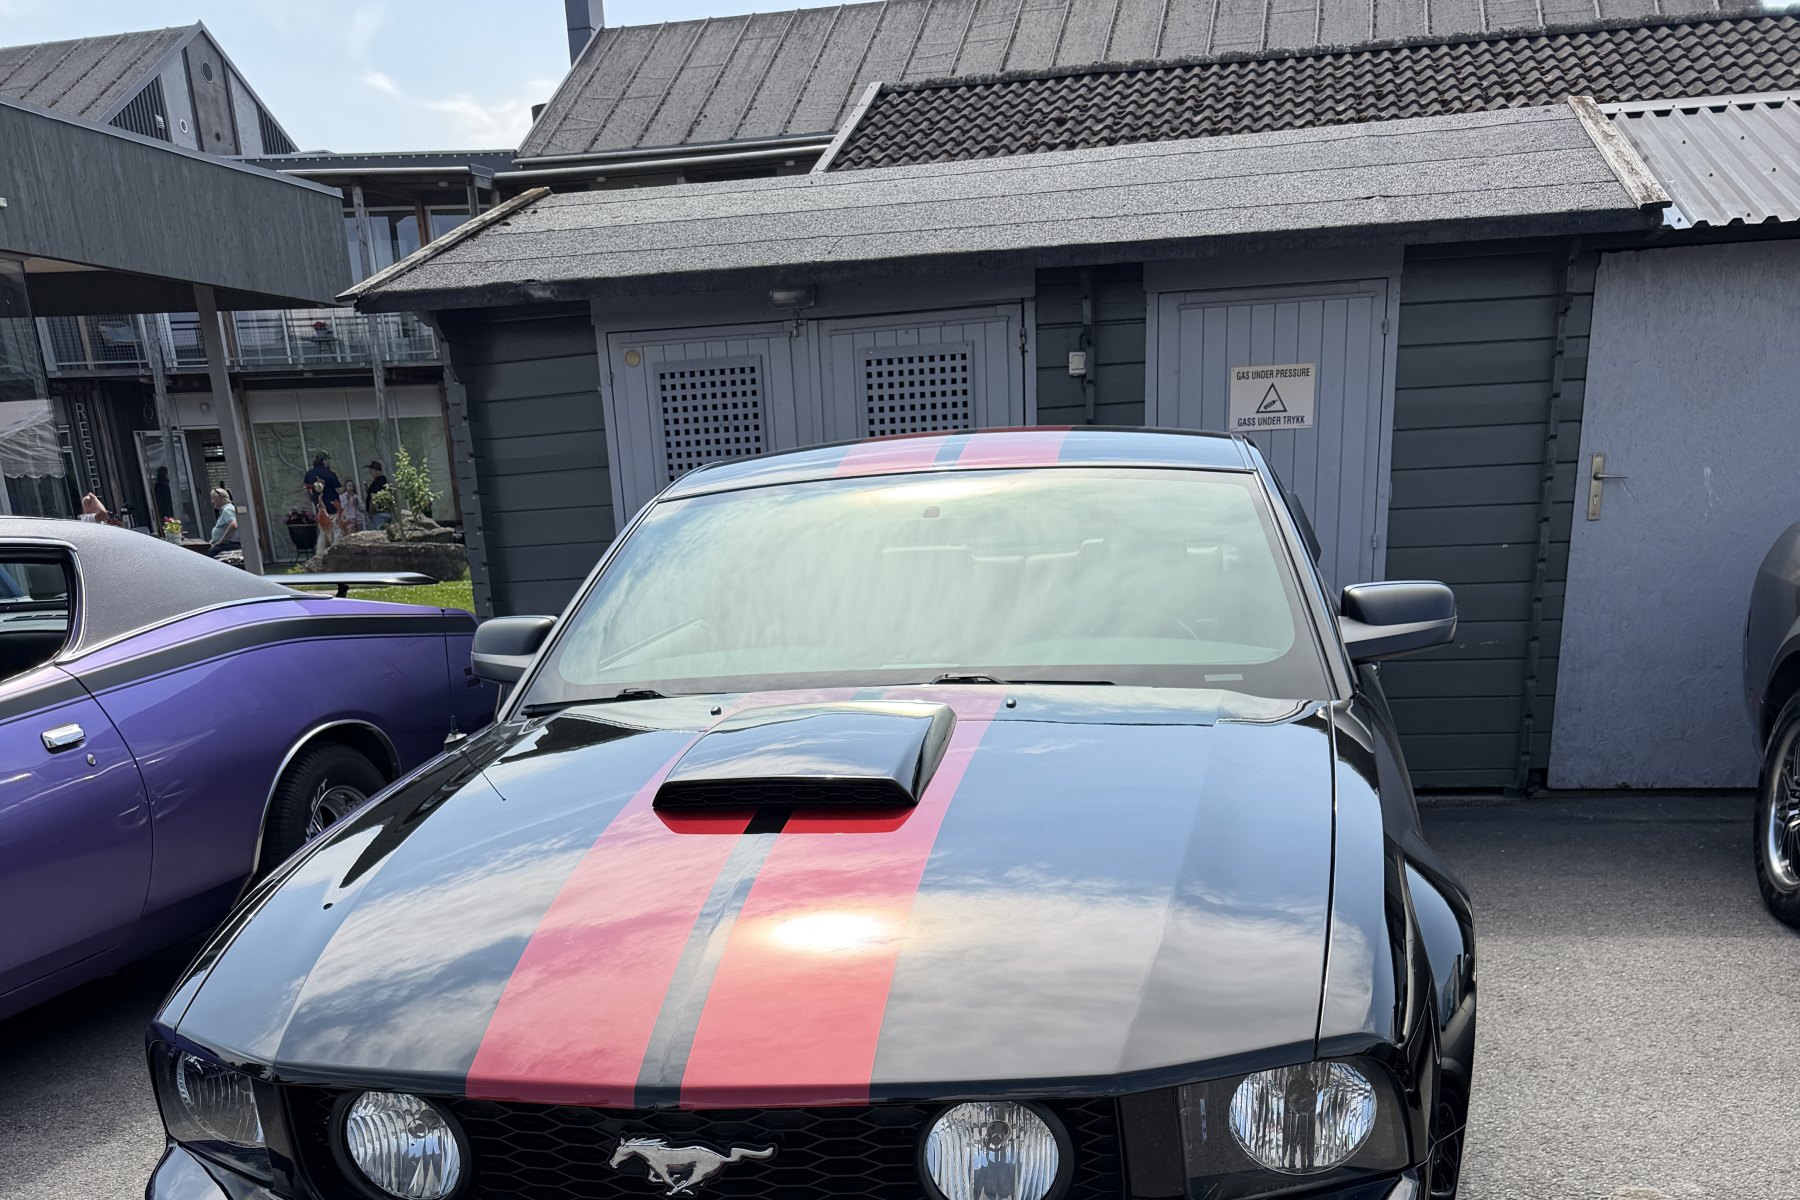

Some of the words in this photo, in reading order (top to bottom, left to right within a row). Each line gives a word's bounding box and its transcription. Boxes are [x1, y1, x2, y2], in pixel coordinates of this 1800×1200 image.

[1236, 371, 1250, 380] GAS
[1252, 370, 1274, 379] UNDER
[1276, 368, 1310, 378] PRESSURE
[1238, 418, 1256, 426] GASS
[1258, 416, 1281, 425] UNDER
[1283, 415, 1305, 424] TRYKK
[75, 402, 102, 497] RESEP
